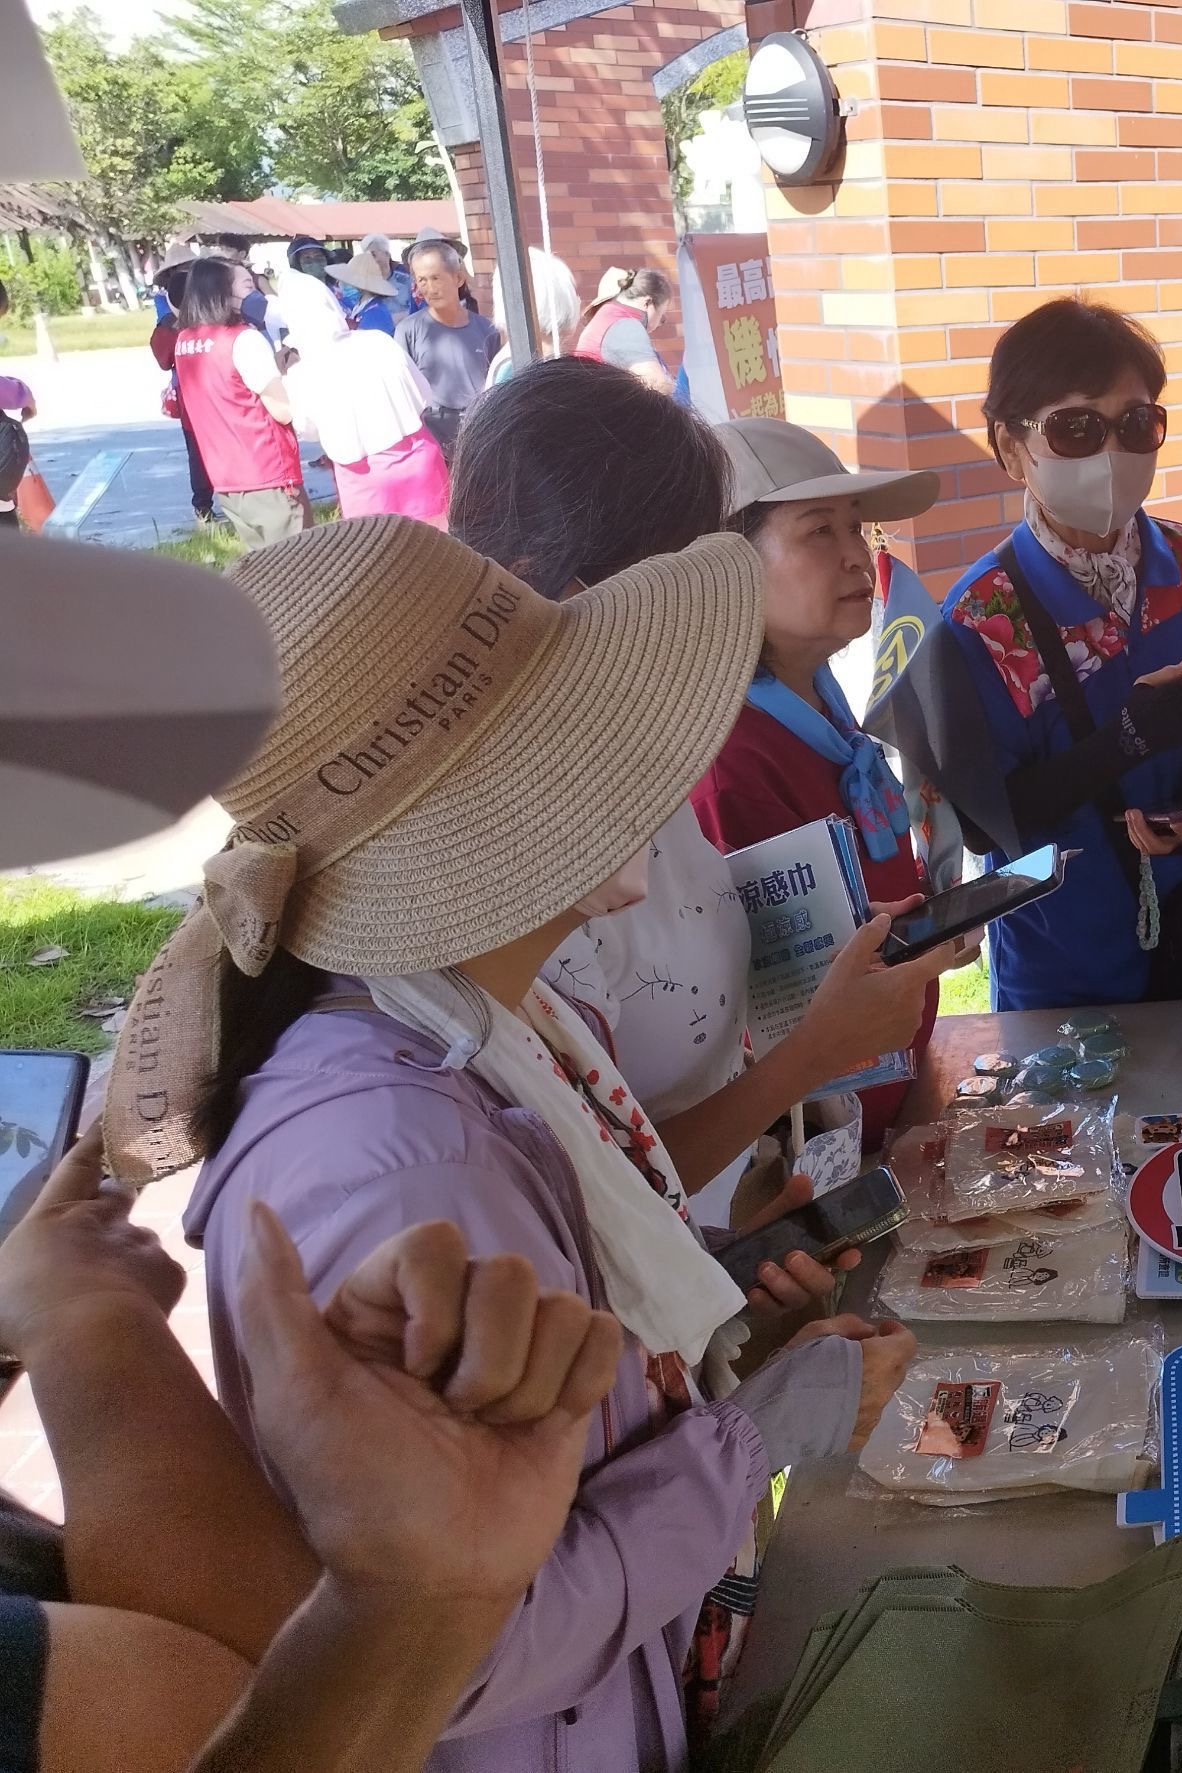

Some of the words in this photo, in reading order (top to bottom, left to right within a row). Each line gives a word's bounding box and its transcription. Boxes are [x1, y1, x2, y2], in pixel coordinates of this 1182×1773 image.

[316, 651, 481, 797] Christian
[460, 582, 522, 651] Dior
[437, 672, 494, 733] PARIS
